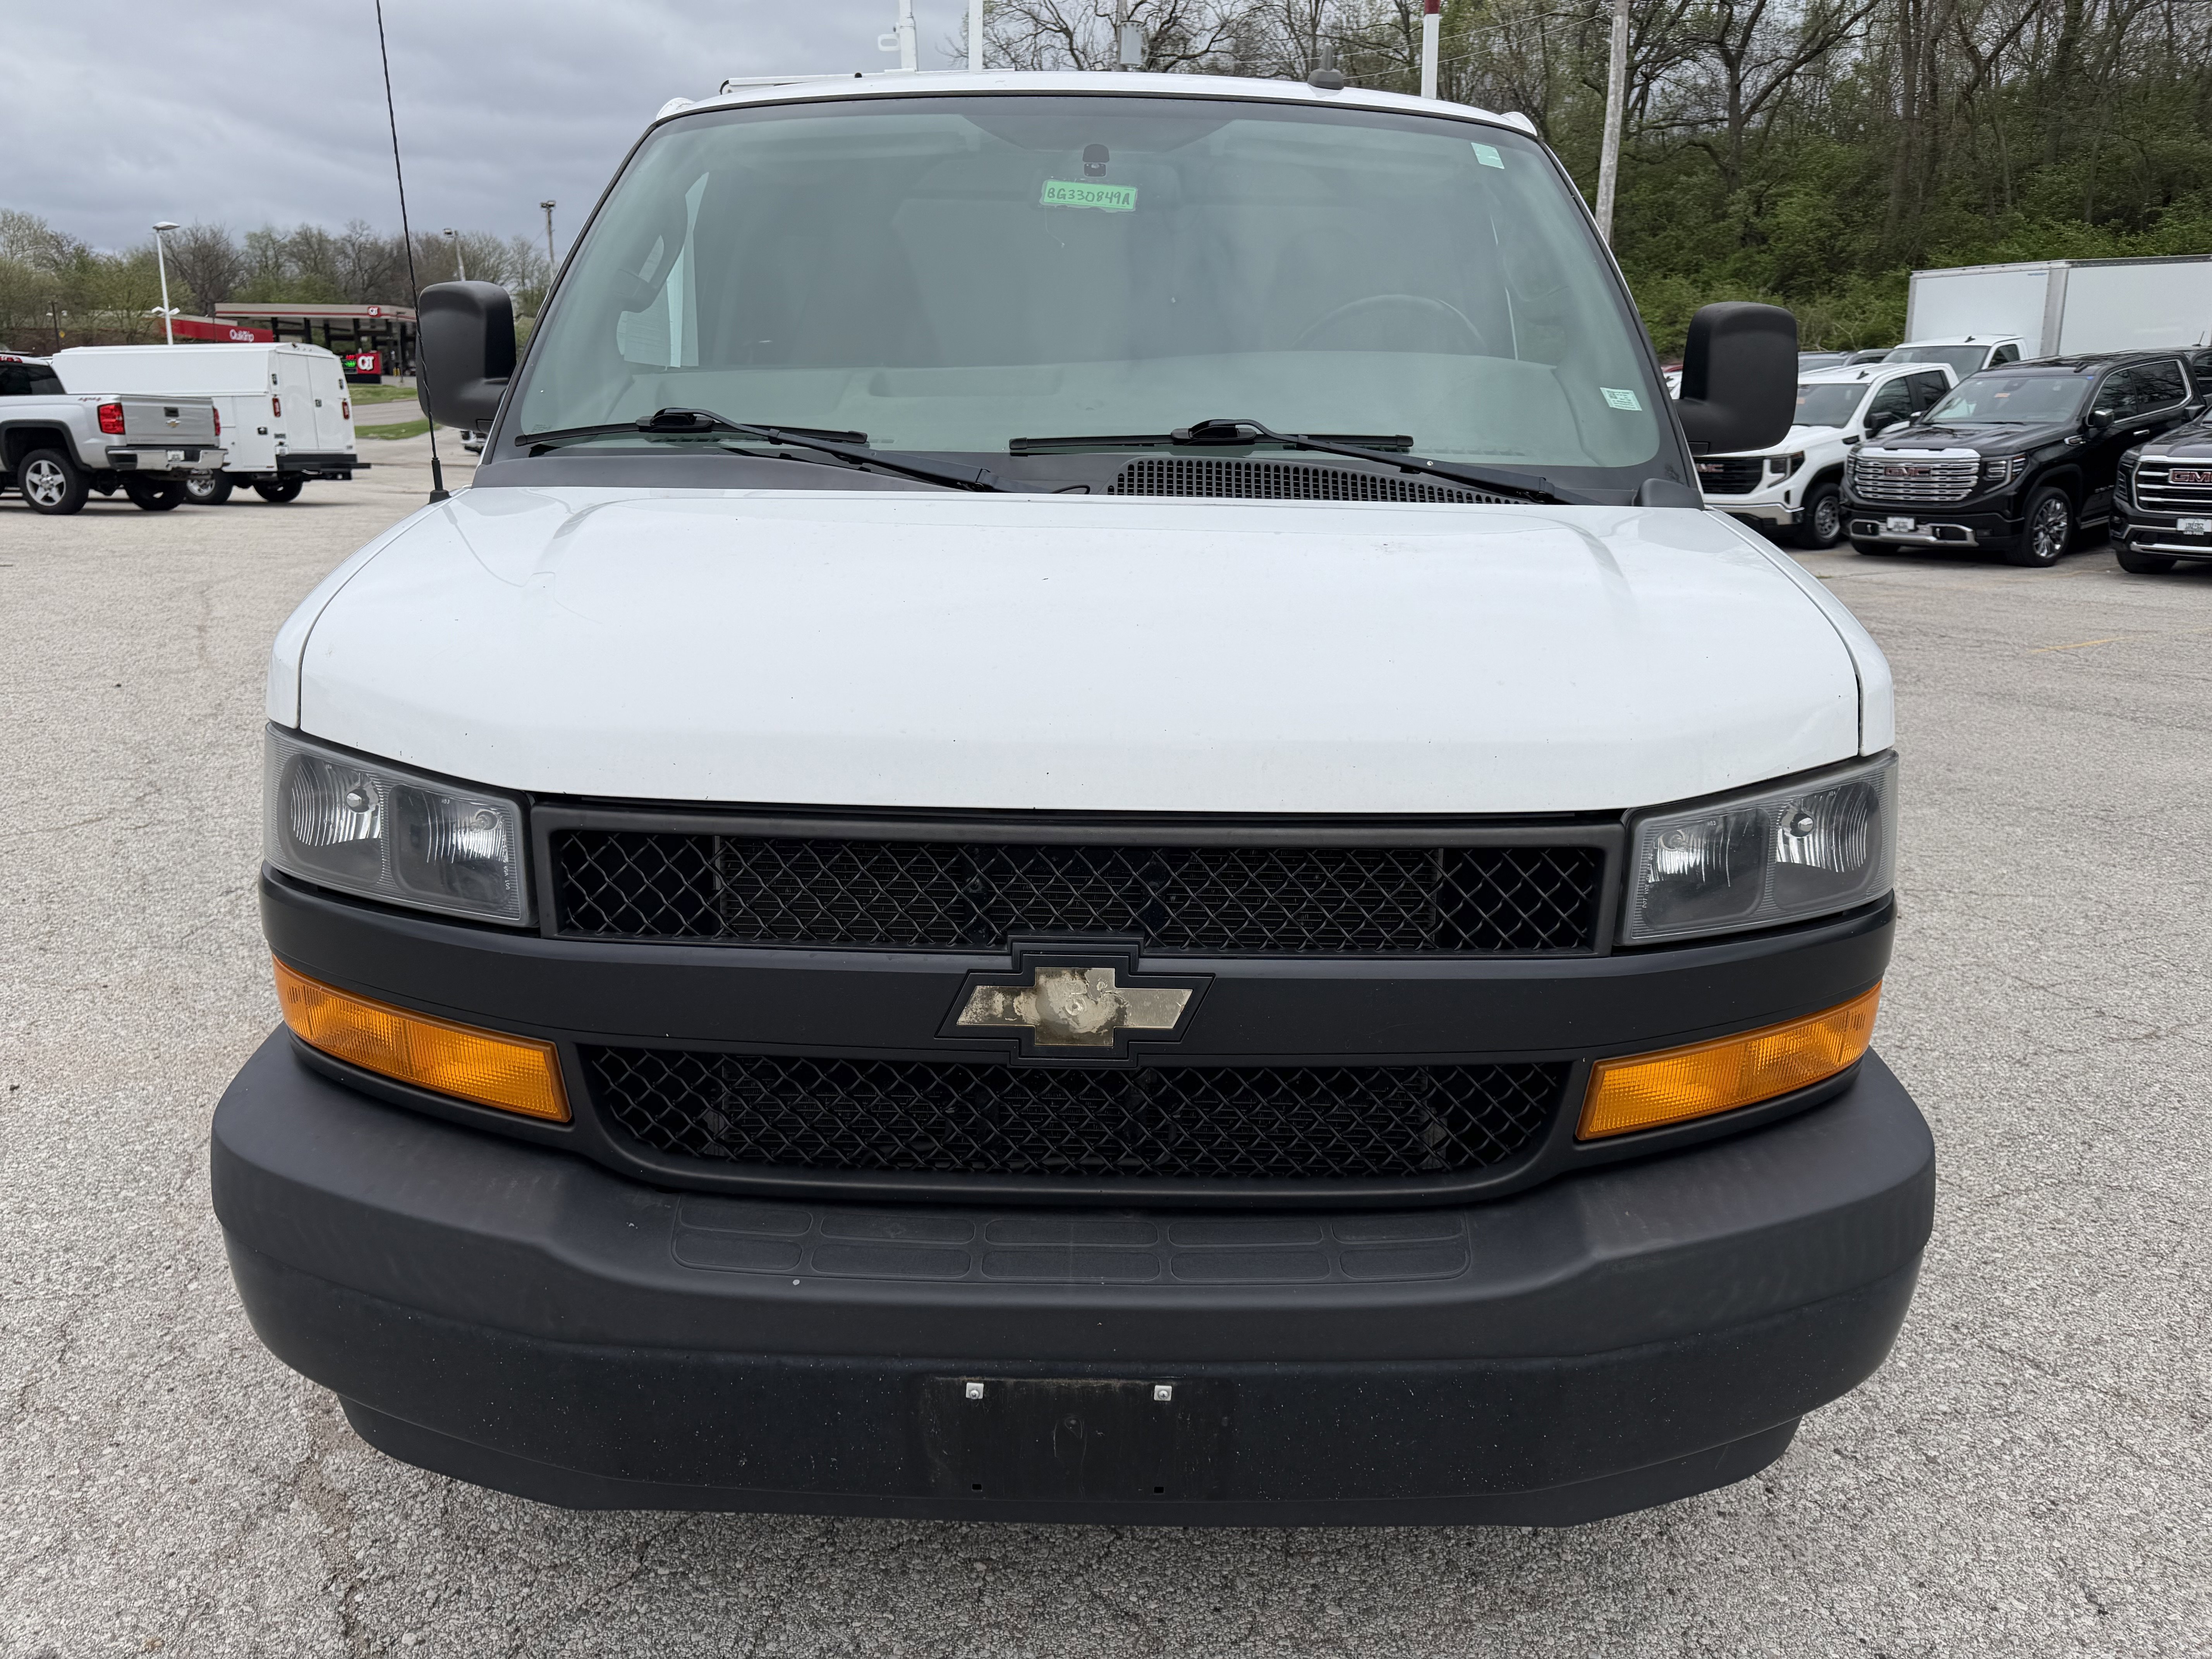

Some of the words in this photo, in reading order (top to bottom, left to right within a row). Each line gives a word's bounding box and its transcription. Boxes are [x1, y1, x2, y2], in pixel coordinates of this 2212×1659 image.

[1047, 187, 1130, 205] BG330849A
[1696, 463, 1724, 472] MC
[1886, 467, 1930, 476] GMC
[2171, 471, 2212, 482] GM
